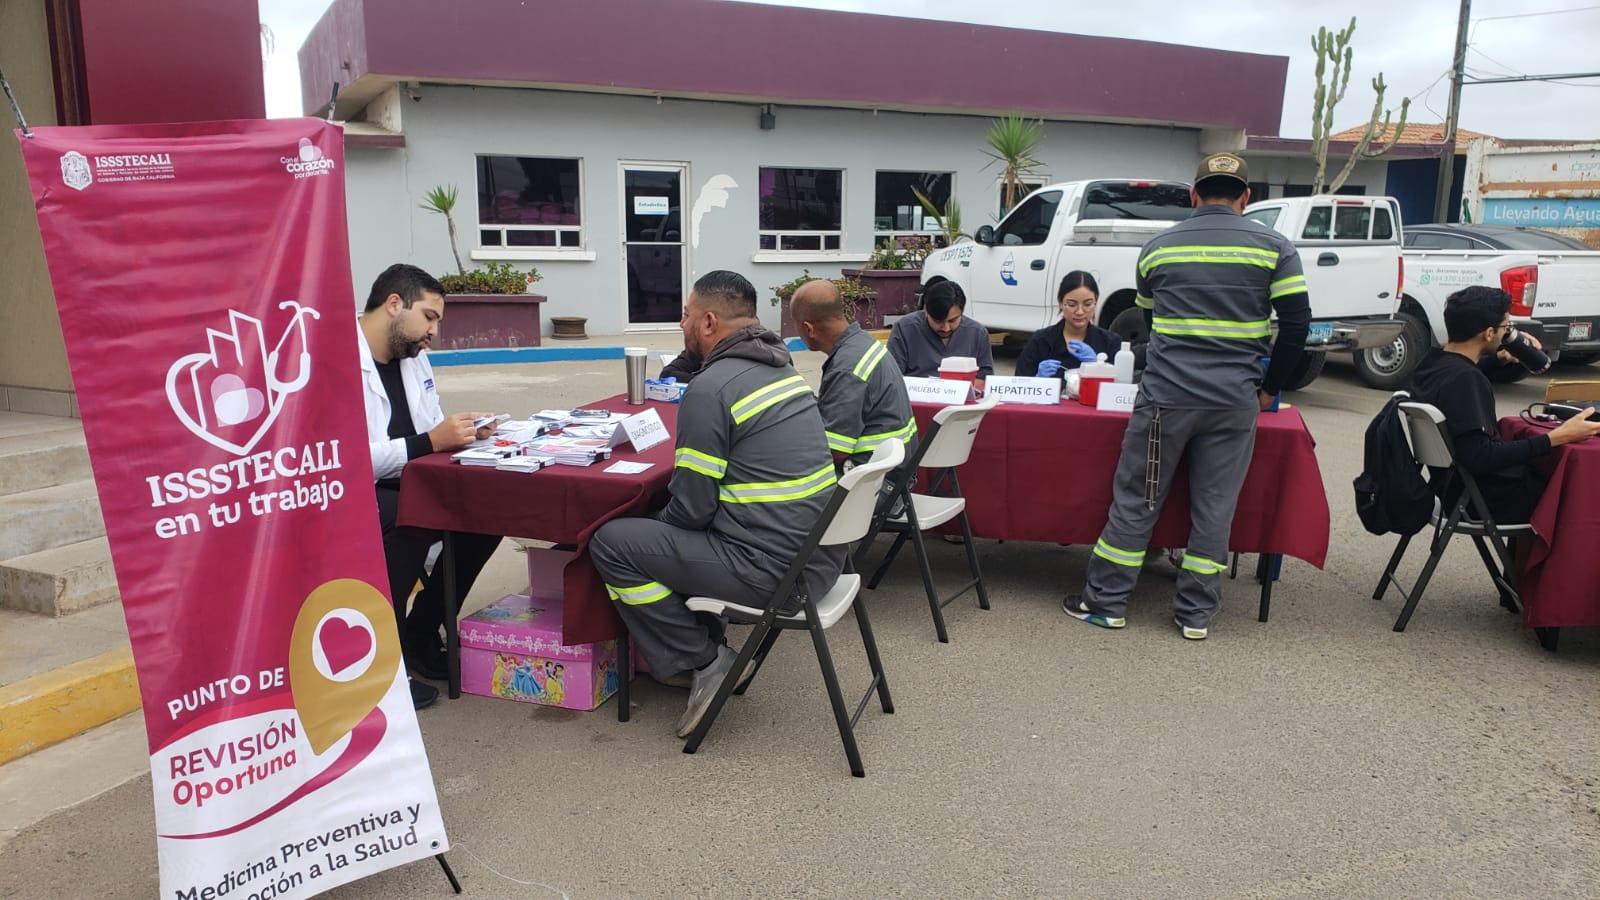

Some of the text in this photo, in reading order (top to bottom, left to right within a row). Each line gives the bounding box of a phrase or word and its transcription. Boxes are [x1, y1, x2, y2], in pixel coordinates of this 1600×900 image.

[94, 153, 172, 167] ISSSTECALI
[286, 156, 335, 173] corazón
[1494, 203, 1600, 225] Llevando Agua
[909, 385, 957, 396] PRUEBAS VIH
[990, 385, 1053, 396] HEPATITIS C
[146, 440, 341, 507] ISSSTECALI
[155, 475, 344, 539] en tu trabajo
[167, 667, 284, 720] PUNTO DE
[170, 718, 297, 780] REVISIÓN
[173, 749, 297, 808] Oportuna
[175, 803, 421, 900] Medicina Preventiva y
[309, 863, 322, 879] a
[326, 851, 349, 872] la
[355, 826, 418, 863] Salud
